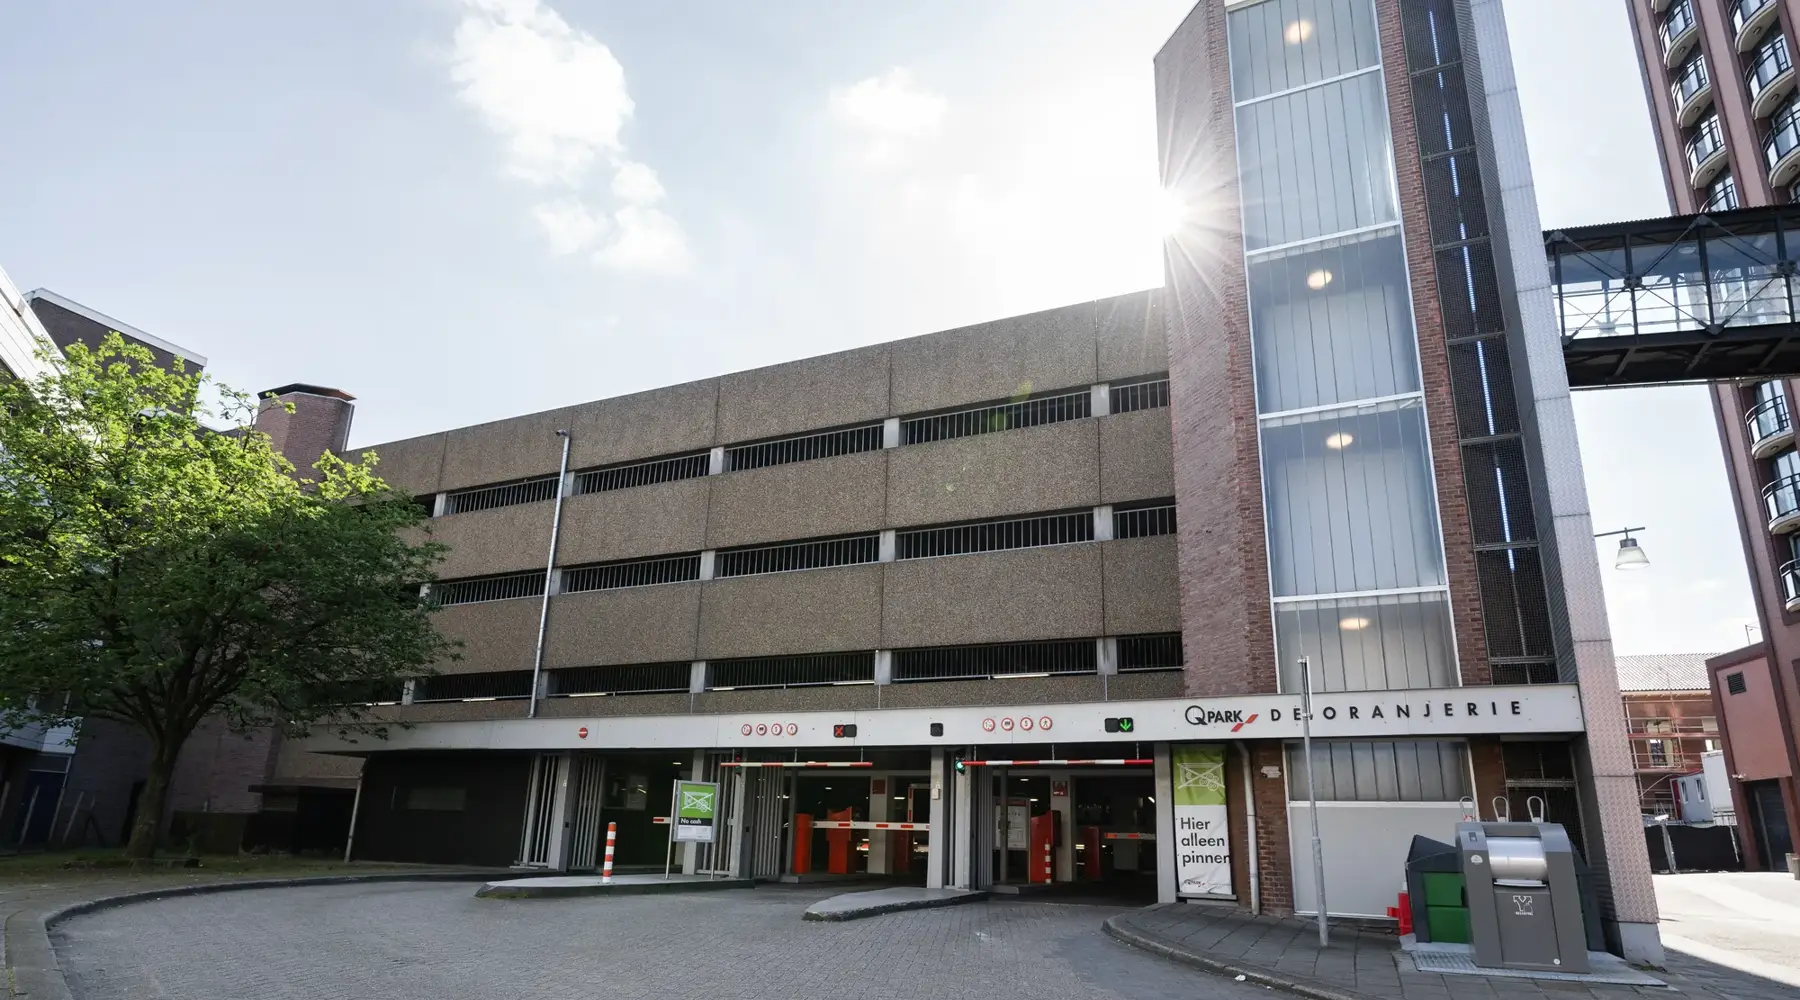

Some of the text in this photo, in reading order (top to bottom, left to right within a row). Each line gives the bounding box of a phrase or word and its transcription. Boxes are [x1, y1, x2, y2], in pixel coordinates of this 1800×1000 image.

[1271, 708, 1302, 721] DE
[1323, 701, 1521, 720] ORANJERIE
[1180, 817, 1210, 829] Hier
[1181, 833, 1225, 846] alleen
[1182, 851, 1232, 867] pinnen
